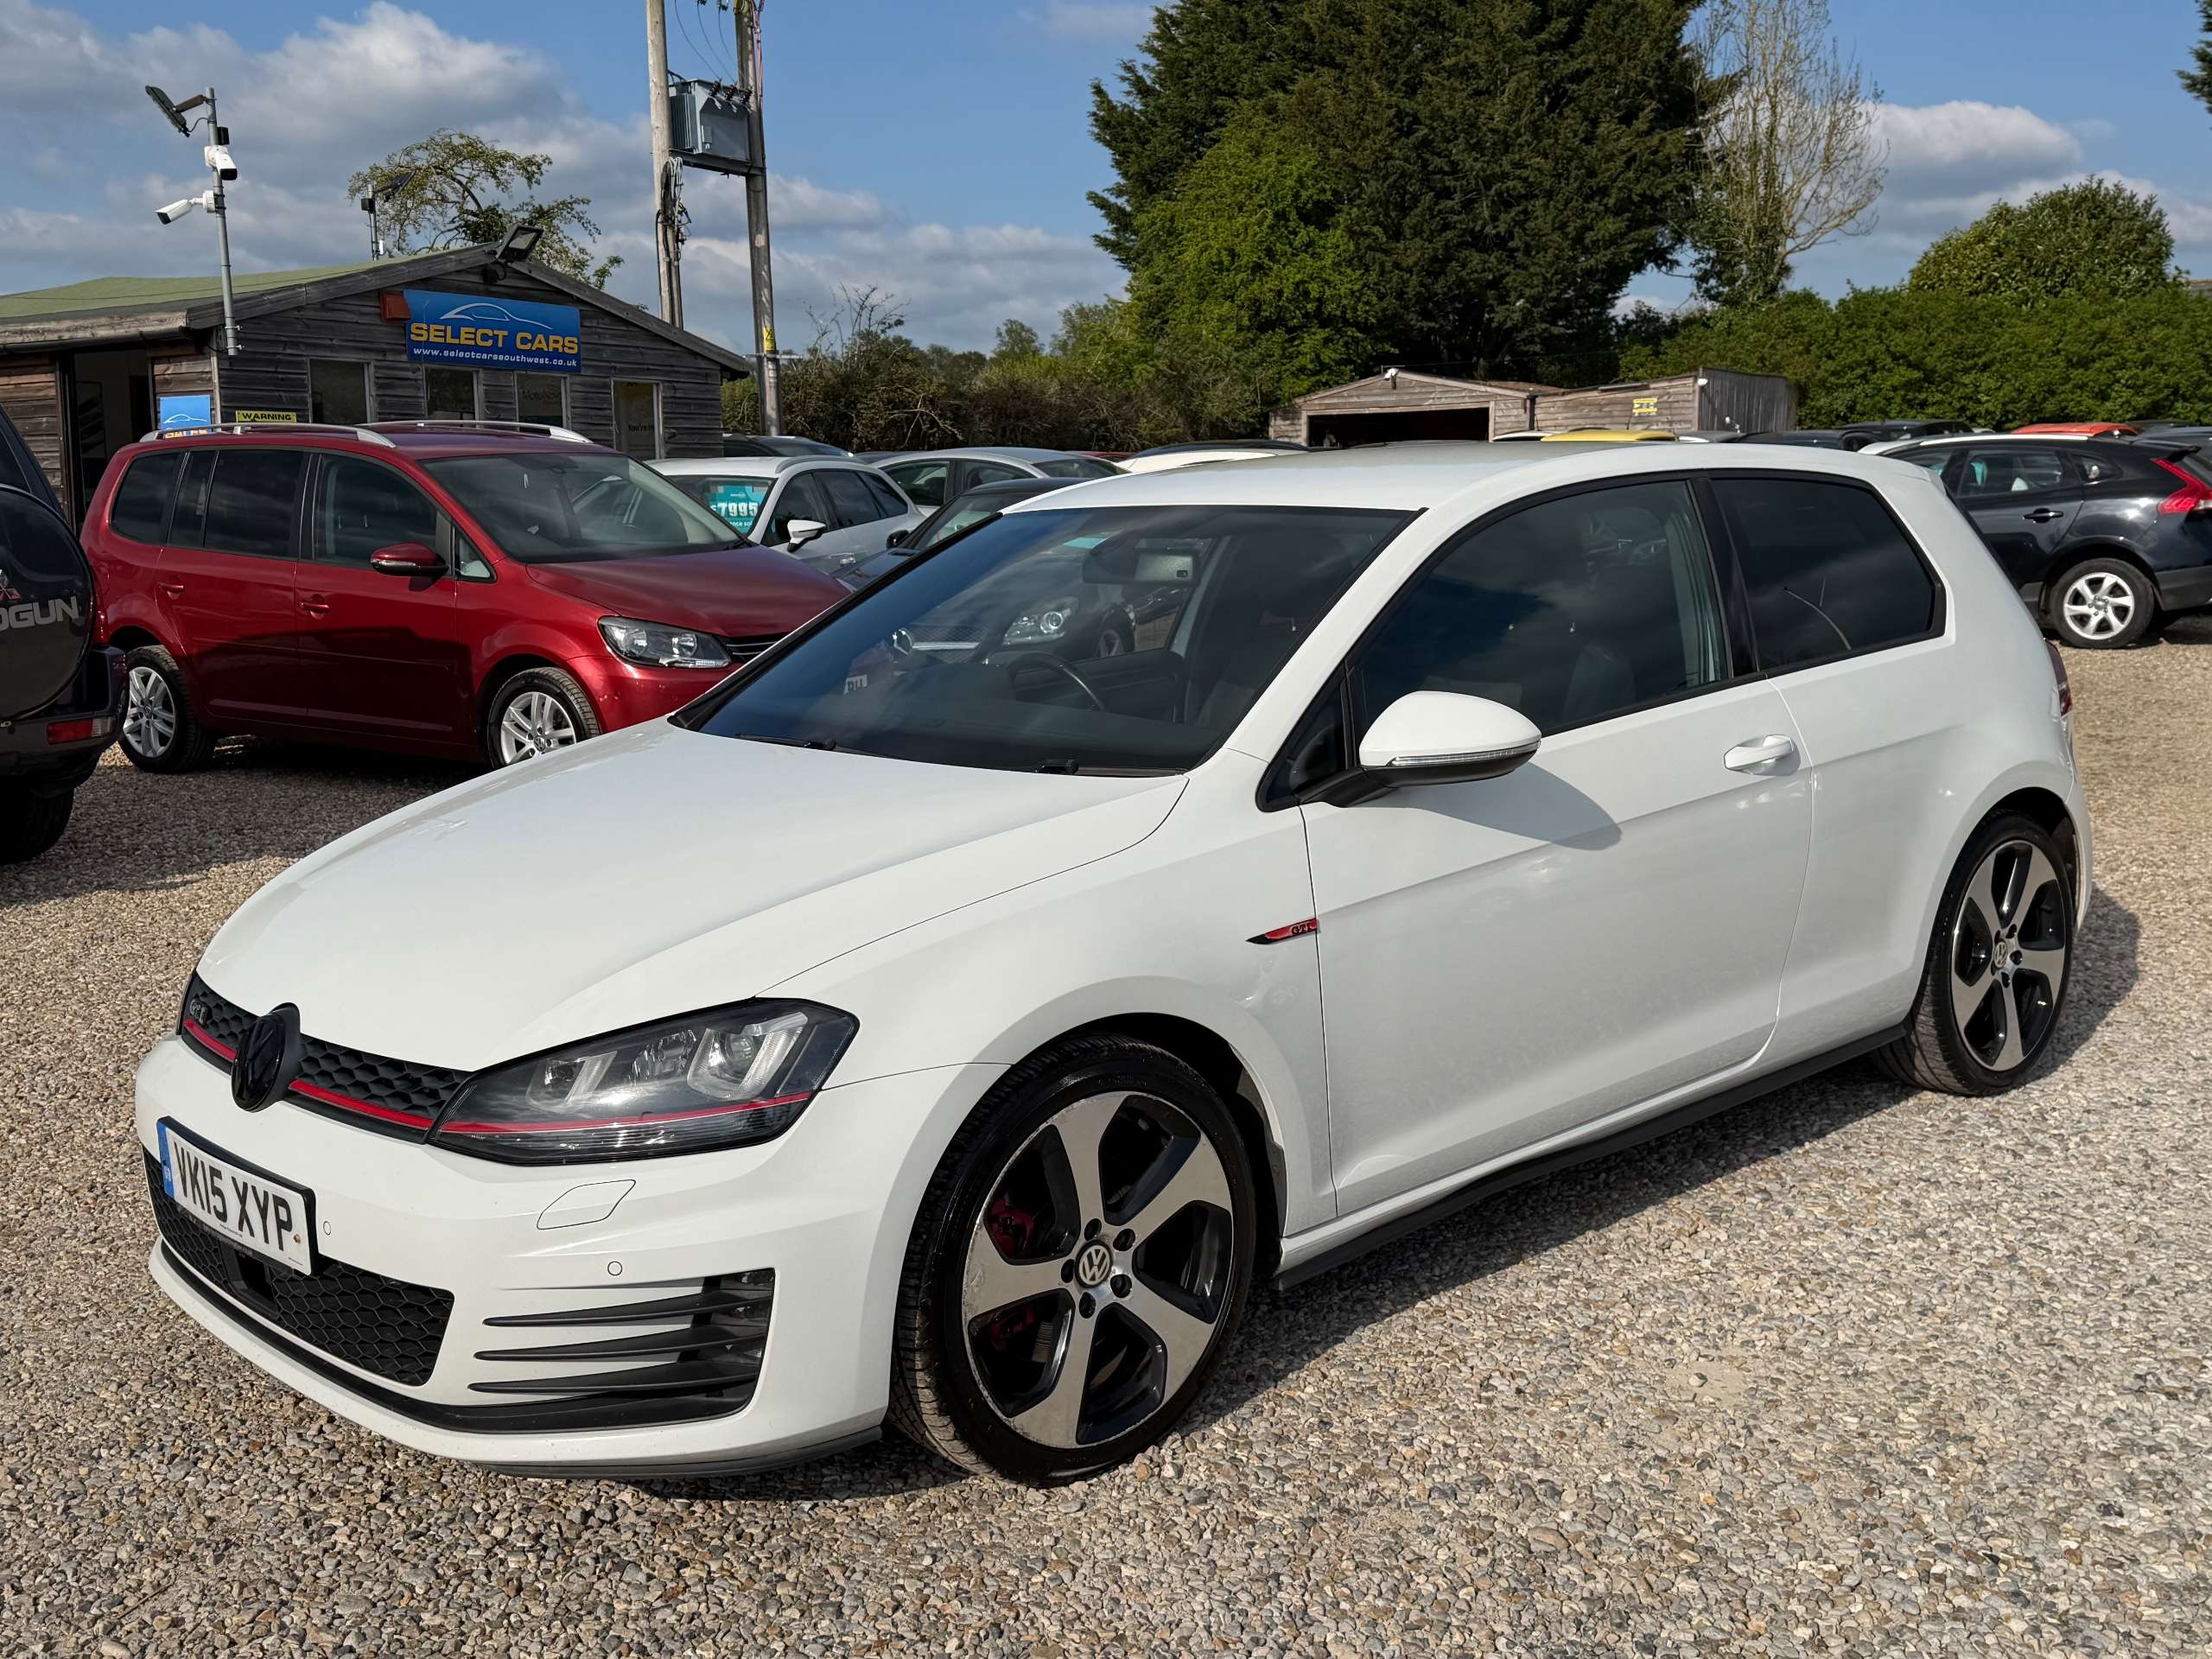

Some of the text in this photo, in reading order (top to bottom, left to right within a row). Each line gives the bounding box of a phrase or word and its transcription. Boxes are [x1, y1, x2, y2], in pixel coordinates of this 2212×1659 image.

[410, 323, 579, 354] SELECT CARS
[413, 347, 577, 367] www.selectcarssouthwest.co.uk
[243, 412, 291, 421] WARNING
[1291, 921, 1314, 934] GTI
[174, 1141, 293, 1251] VK15 XYP
